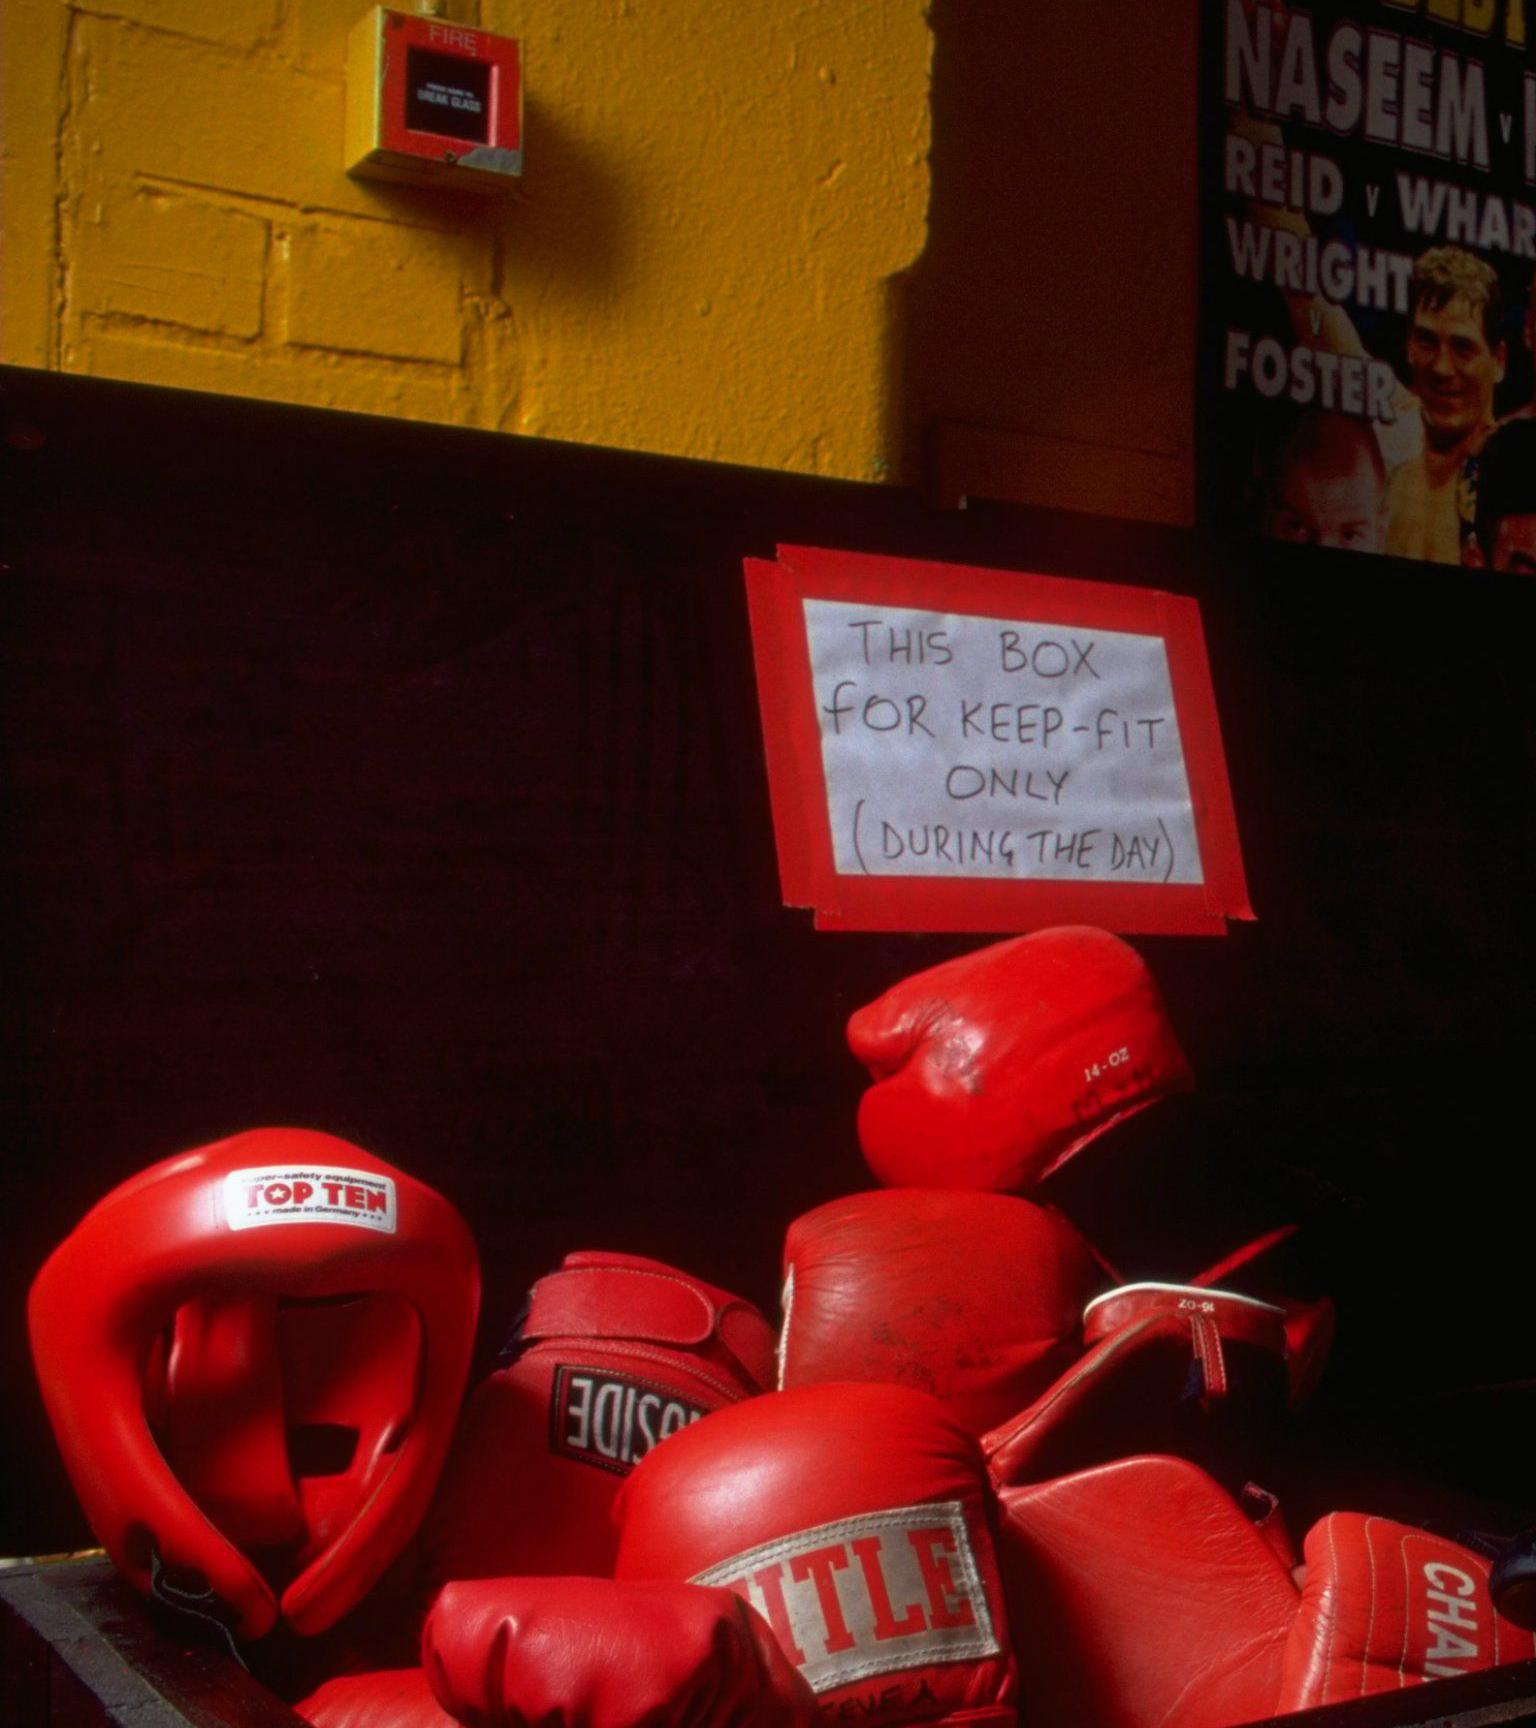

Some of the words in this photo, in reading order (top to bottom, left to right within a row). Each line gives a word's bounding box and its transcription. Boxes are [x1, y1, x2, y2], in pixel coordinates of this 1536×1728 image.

[428, 25, 477, 49] FIRE
[1222, 0, 1493, 172] NASEEM
[1224, 135, 1345, 216] REID
[1226, 214, 1416, 316] WRIGHT
[1224, 327, 1398, 426] FOSTER
[849, 620, 953, 667] THIS
[999, 631, 1100, 679] BOX
[961, 700, 1166, 751] KEEP-FIT
[945, 764, 1070, 805] ONLY
[853, 799, 1015, 877] (DURING
[1026, 830, 1102, 871] THE
[1110, 815, 1177, 885] DAY)
[245, 1181, 314, 1209] TOP
[321, 1182, 387, 1216] TEN
[325, 1173, 386, 1190] equipment
[272, 1206, 302, 1214] made
[303, 1205, 314, 1213] in
[314, 1205, 360, 1218] Germany
